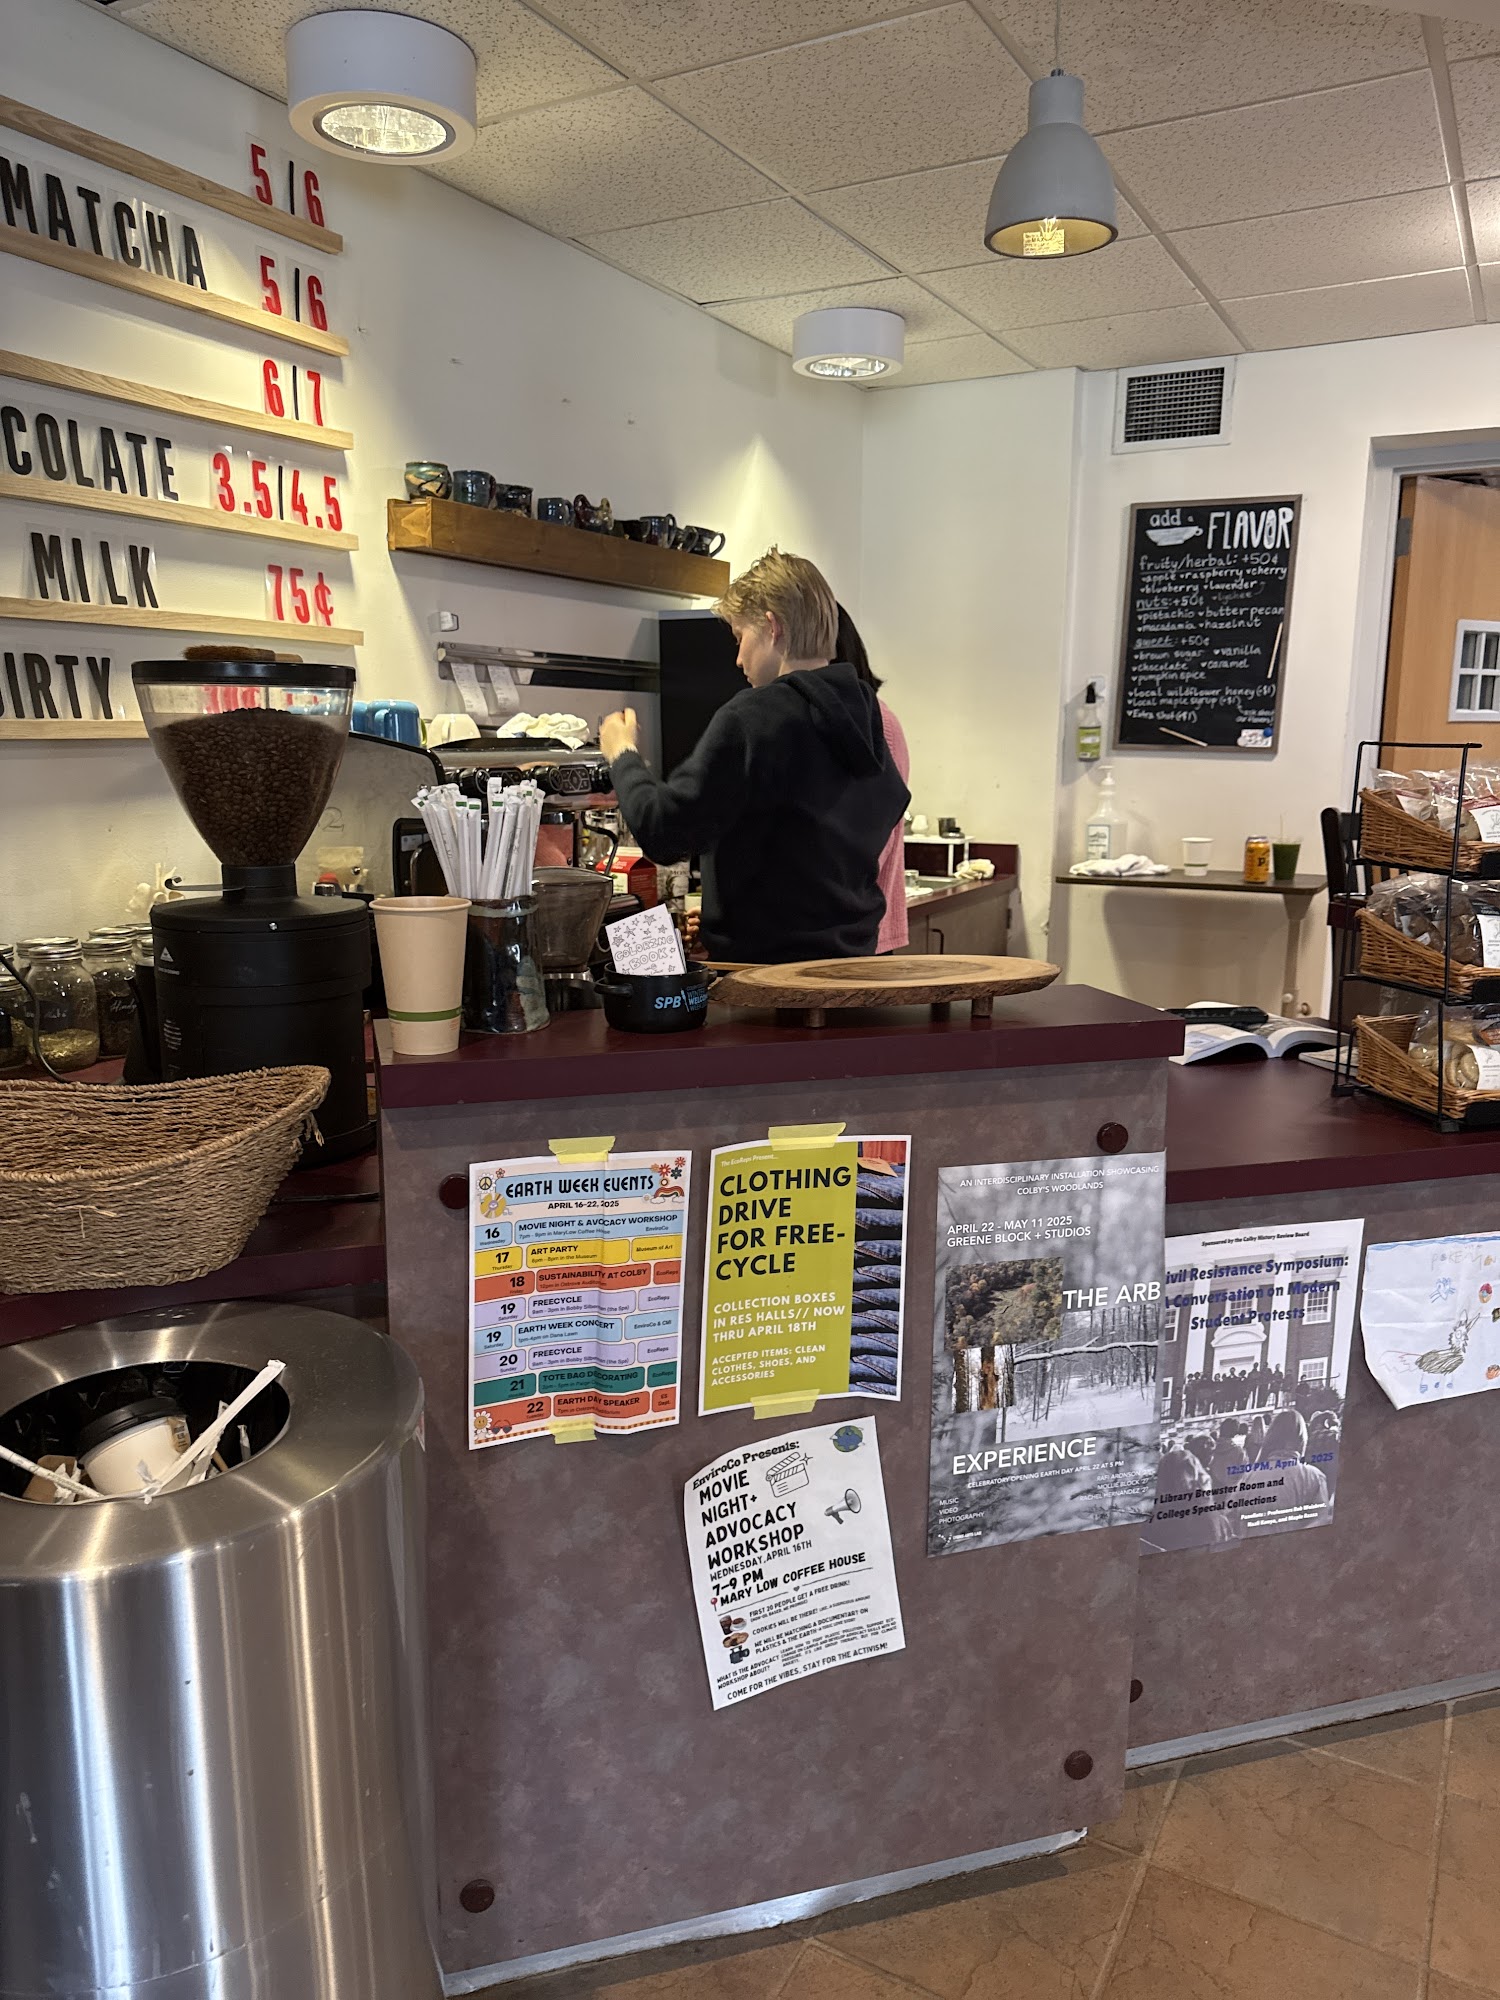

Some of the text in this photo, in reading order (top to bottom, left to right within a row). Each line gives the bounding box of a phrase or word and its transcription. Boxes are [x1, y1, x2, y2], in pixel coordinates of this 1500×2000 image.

[0, 156, 208, 291] MATCHA
[1150, 509, 1181, 527] add
[1207, 507, 1294, 549] FLAVOR
[31, 532, 334, 627] MILK 75¢
[1185, 568, 1243, 583] raspberry
[1251, 566, 1287, 580] cherry
[1145, 578, 1258, 595] blueberry lavender
[1205, 617, 1262, 629] hazelnut
[1139, 644, 1261, 661] brown sugar vanilla
[1137, 658, 1250, 672] chocolate caramel
[0, 652, 113, 719] IRTY
[1180, 671, 1206, 683] spice
[614, 935, 675, 962] COLORING
[629, 948, 669, 970] BOOK
[654, 996, 682, 1009] SPB
[720, 1166, 852, 1197] CLOTHING
[974, 1174, 1050, 1186] INTERDISCIPLINARY
[1051, 1170, 1105, 1180] INSTALLATION
[1106, 1166, 1160, 1175] SHOWCASING
[505, 1175, 654, 1199] EARTH WEEK EVENTS
[1017, 1182, 1104, 1195] COLBY'S WOODLANDS
[548, 1202, 573, 1210] APRIL
[600, 1200, 620, 1208] 2025
[719, 1197, 792, 1226] DRIVE
[519, 1221, 547, 1231] MOVIE
[548, 1220, 576, 1228] NIGHT
[628, 1214, 678, 1225] WORKSHOP
[947, 1224, 978, 1235] APRIL
[981, 1222, 994, 1231] 22
[1004, 1219, 1028, 1230] MAY
[1031, 1219, 1042, 1227] 11
[1047, 1216, 1073, 1226] 2025
[485, 1227, 500, 1239] 16
[718, 1223, 846, 1254] FOR FREE-
[947, 1234, 992, 1247] GREENE
[995, 1231, 1031, 1243] BLOCK
[1044, 1226, 1091, 1239] STUDIOS
[495, 1252, 510, 1264] 17
[531, 1245, 579, 1255] ART PARTY
[538, 1268, 648, 1281] SUSTAINABILITY AT COLBY
[716, 1252, 796, 1281] CYCLE
[1190, 1263, 1263, 1281] Resistance
[1265, 1255, 1349, 1275] Symposium:
[510, 1276, 525, 1287] 18
[533, 1296, 583, 1307] FREECYCLE
[714, 1292, 836, 1314] COLLECTION BOXES
[1062, 1286, 1109, 1310] THE
[1115, 1281, 1161, 1304] ARB
[1173, 1286, 1264, 1308] Conversation
[1267, 1286, 1284, 1297] on
[1287, 1280, 1341, 1295] Modern
[500, 1302, 516, 1314] 19
[714, 1317, 727, 1329] IN
[730, 1313, 754, 1327] RES
[814, 1305, 846, 1317] NOW
[518, 1320, 615, 1334] EARTH WEEK CONCERT
[1190, 1308, 1305, 1330] Student Protests
[486, 1331, 502, 1343] 19
[712, 1321, 817, 1343] THRU APRIL 18TH
[499, 1354, 518, 1367] 20
[533, 1346, 583, 1358] FREECYCLE
[712, 1344, 826, 1366] ACCEPTED ITEMS: CLEAN
[543, 1371, 638, 1381] TOTE BAG DECORATING
[711, 1356, 817, 1376] CLOTHES, SHOES, AND
[510, 1379, 525, 1391] 21
[711, 1369, 775, 1386] ACCESSORIES
[527, 1401, 544, 1414] 22
[557, 1395, 640, 1406] EARTH DAY SPEAKER
[692, 1441, 800, 1490] EnviroCo Presents:
[953, 1437, 1097, 1475] EXPERIENCE
[968, 1477, 1010, 1489] CELEBRATORY
[1010, 1473, 1039, 1482] OPENING
[1040, 1469, 1060, 1477] EARTH
[1061, 1467, 1074, 1475] DAY
[1074, 1465, 1091, 1473] APRIL
[699, 1469, 750, 1506] MOVIE
[1160, 1477, 1284, 1503] Library Brewster Room and
[701, 1493, 748, 1527] NIGHT
[939, 1498, 959, 1506] MUSIC
[939, 1507, 958, 1515] VIDEO
[1156, 1494, 1277, 1520] College Special Collections
[705, 1501, 797, 1549] ADVOCACY
[939, 1512, 985, 1525] PHOTOGRAPHY
[708, 1523, 804, 1570] WORKSHOP
[767, 1549, 791, 1561] APRIL
[793, 1540, 813, 1553] 16TH
[720, 1552, 866, 1606] MARY LOW COFFEE HOUSE
[742, 1568, 764, 1585] PM
